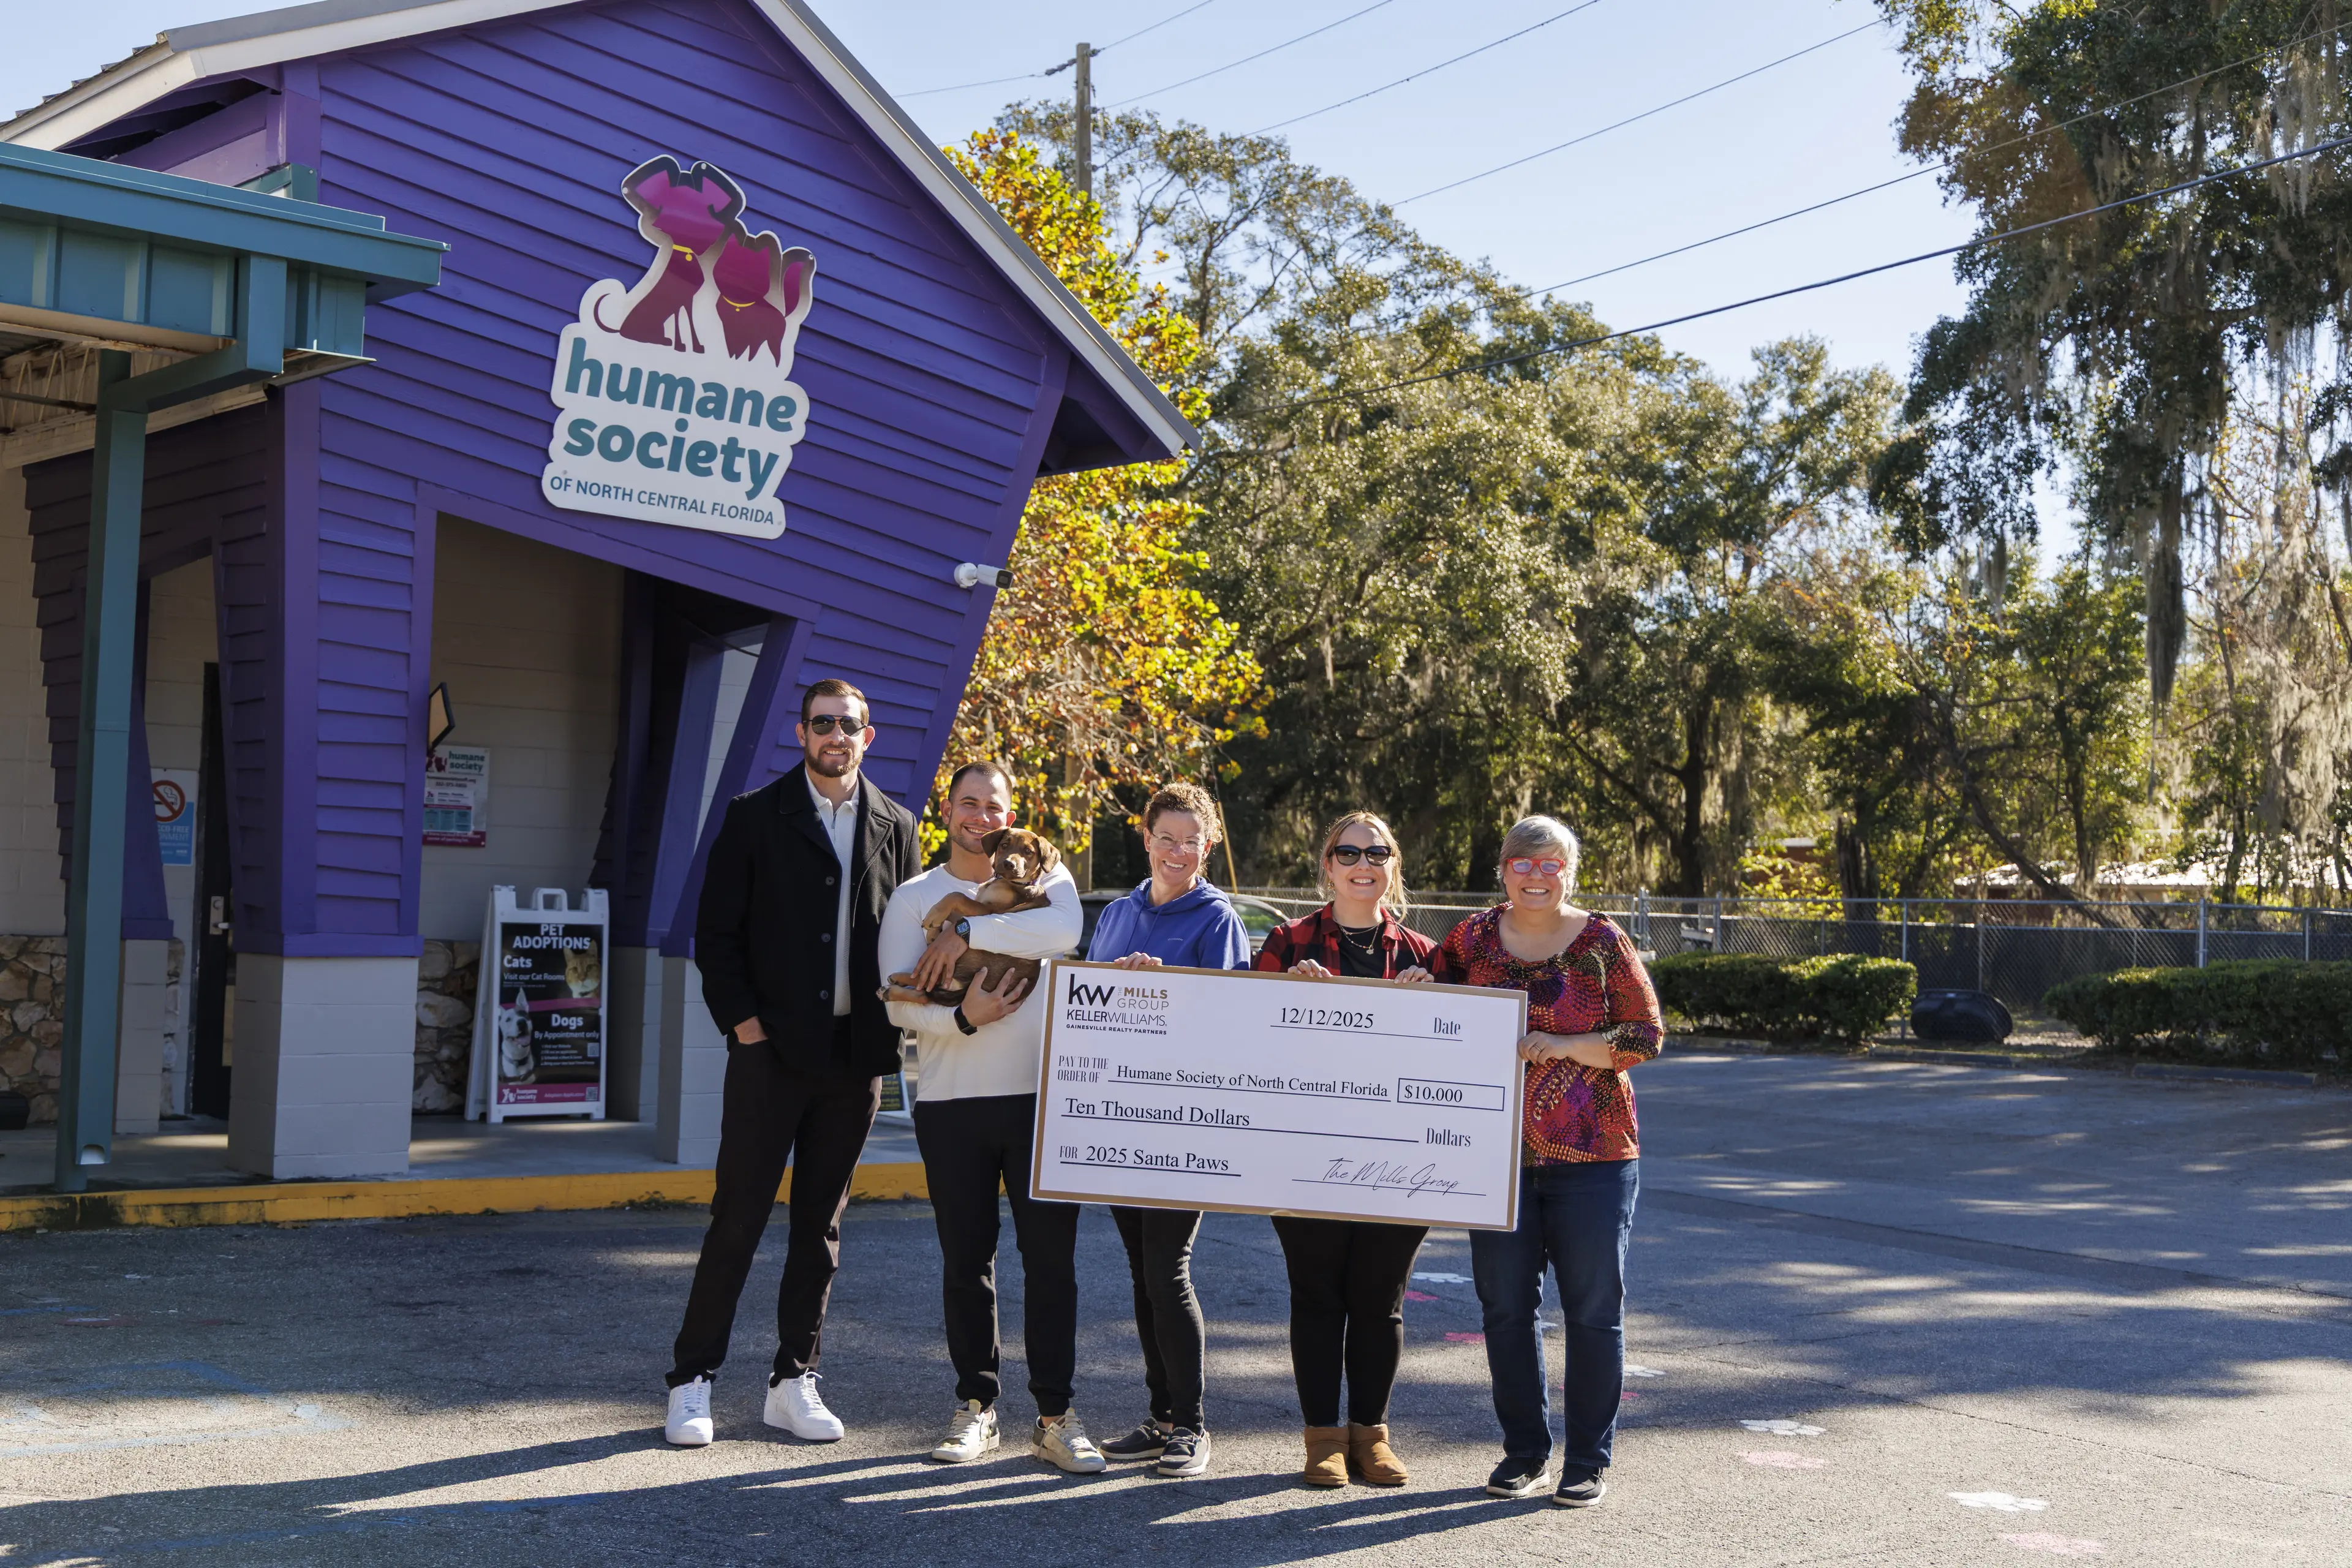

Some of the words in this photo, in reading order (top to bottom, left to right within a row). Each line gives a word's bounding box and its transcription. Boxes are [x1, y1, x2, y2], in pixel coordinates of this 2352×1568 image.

[565, 337, 797, 432] humane
[563, 418, 780, 500] society
[550, 476, 573, 491] OF
[576, 480, 633, 502] NORTH
[637, 491, 707, 514] CENTRAL
[710, 502, 774, 524] FLORIDA
[448, 750, 485, 761] humane
[450, 761, 483, 772] society
[540, 923, 565, 936] PET
[513, 936, 591, 949] ADOPTIONS
[503, 954, 532, 968] Cats
[1124, 987, 1167, 999] MILLS
[1117, 998, 1169, 1011] GROUP
[551, 1013, 584, 1030] Dogs
[1280, 1008, 1374, 1029] 12/12/2025
[1433, 1017, 1461, 1036] Date
[534, 1031, 543, 1039] By
[544, 1031, 584, 1039] Appointment
[586, 1030, 600, 1039] only
[1058, 1055, 1076, 1068] PAY
[1078, 1056, 1089, 1068] TO
[1091, 1057, 1109, 1069] THE
[1057, 1069, 1087, 1082] ORDER
[1089, 1071, 1100, 1083] OF
[1117, 1065, 1172, 1081] Humane
[1176, 1069, 1224, 1089] Society
[1229, 1073, 1244, 1087] of
[1246, 1074, 1284, 1089] North
[1289, 1077, 1336, 1093] Central
[1341, 1080, 1388, 1097] Florida
[1404, 1084, 1463, 1103] $10,000
[1066, 1098, 1096, 1115] Ten
[1102, 1100, 1183, 1122] Thousand
[1189, 1107, 1250, 1126] Dollars
[1426, 1128, 1471, 1147] Dollars
[1060, 1145, 1078, 1159] FOR
[1086, 1146, 1127, 1164] 2025
[1133, 1149, 1179, 1169] Santa
[1185, 1152, 1229, 1172] Paws
[1322, 1158, 1353, 1181] The
[1352, 1161, 1408, 1190] Mills
[1408, 1163, 1459, 1198] Group
